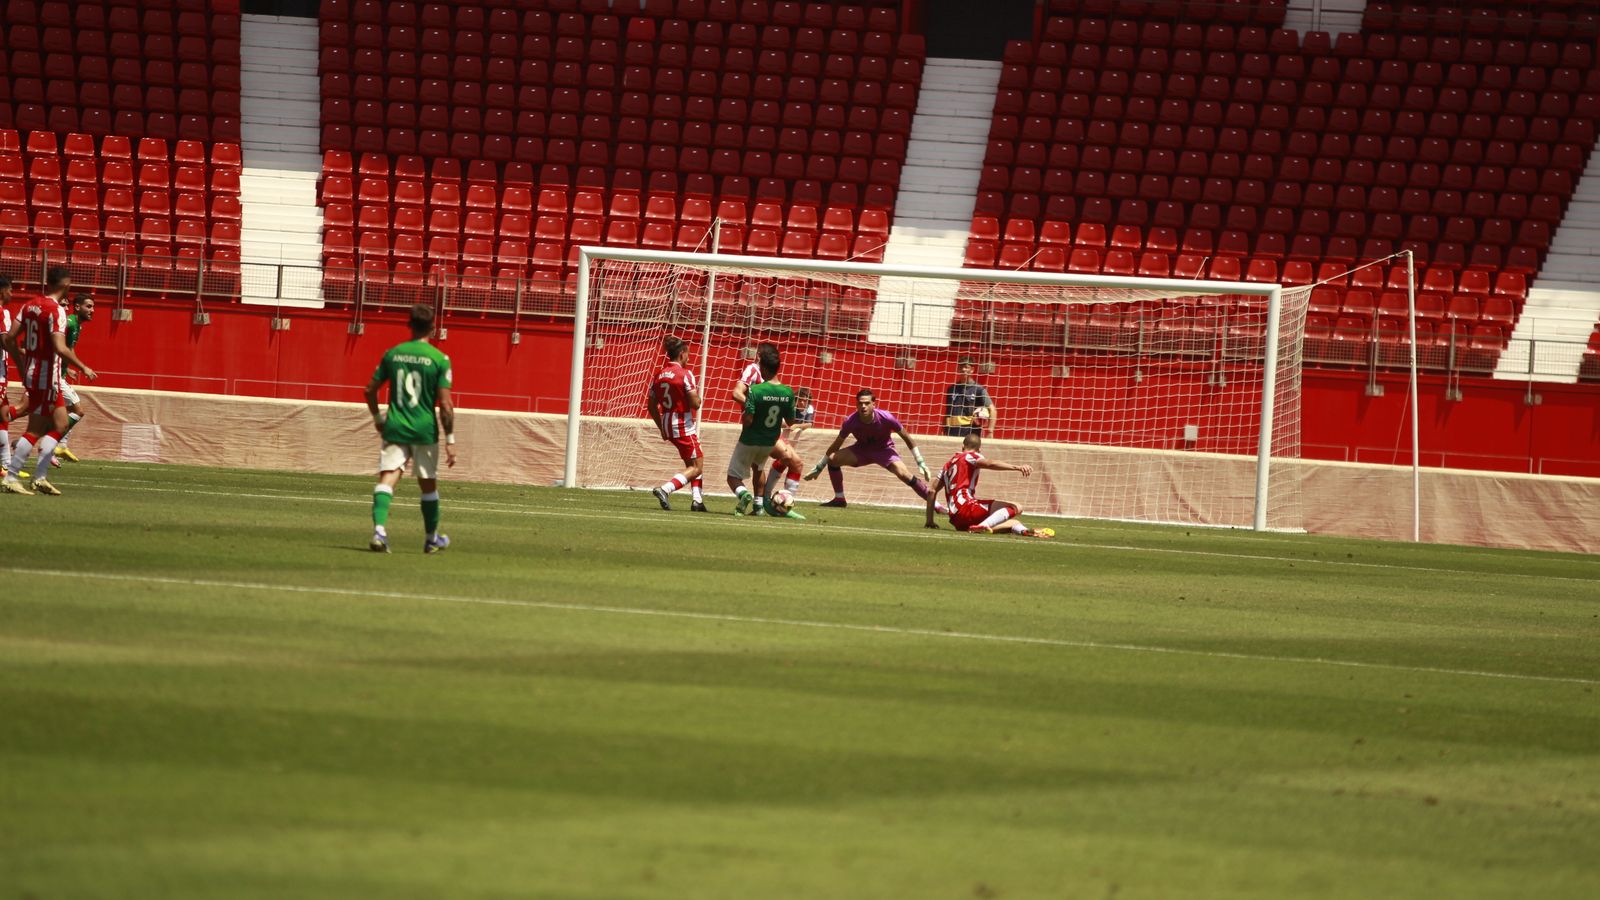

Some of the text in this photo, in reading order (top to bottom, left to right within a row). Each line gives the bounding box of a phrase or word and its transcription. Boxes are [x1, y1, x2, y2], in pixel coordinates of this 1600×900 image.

[25, 318, 38, 351] 16
[392, 354, 432, 366] ANGELITO
[396, 368, 422, 408] 19
[660, 382, 673, 409] 3
[764, 405, 780, 428] 8
